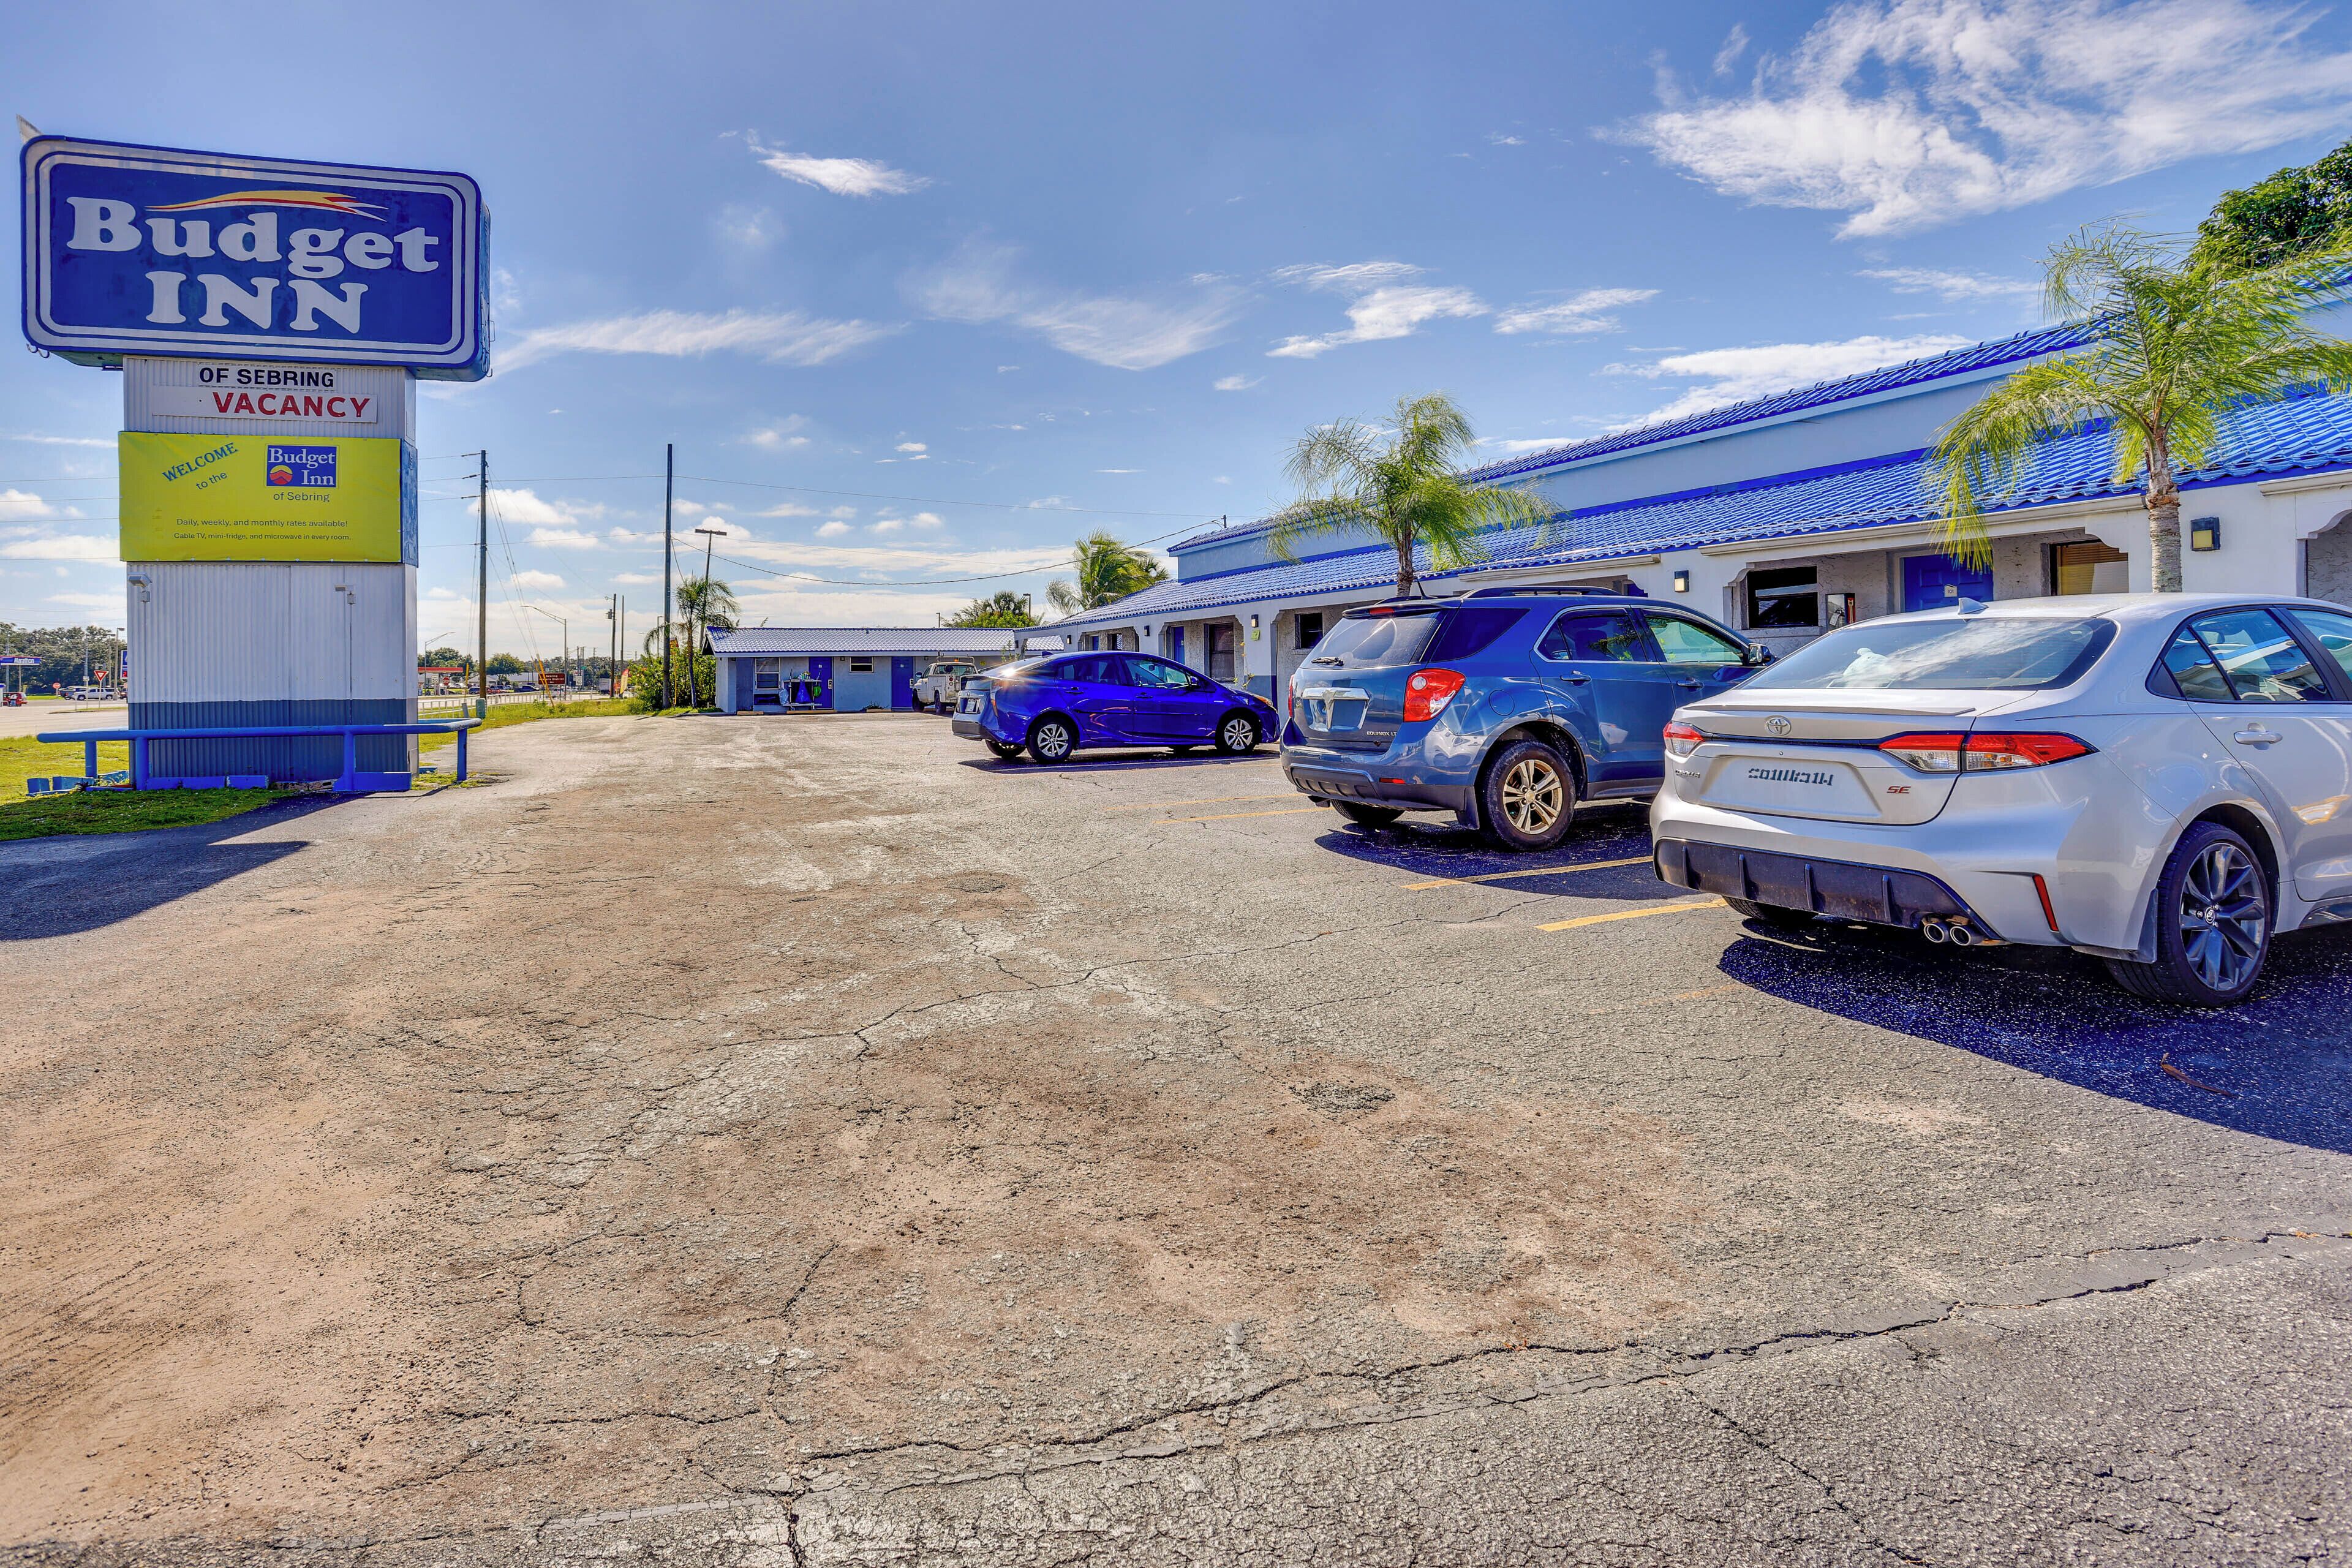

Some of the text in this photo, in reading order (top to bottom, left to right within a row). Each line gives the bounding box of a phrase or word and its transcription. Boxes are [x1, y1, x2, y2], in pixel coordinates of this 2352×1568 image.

[66, 196, 440, 279] Budget
[145, 270, 369, 334] INN
[198, 367, 334, 388] OF SEBRING
[212, 391, 371, 418] VACANCY
[162, 442, 239, 482] WELCOME
[268, 448, 336, 469] Budget
[195, 472, 228, 490] to the
[301, 469, 336, 486] Inn
[273, 491, 330, 502] of Sebring
[1887, 786, 1912, 794] SE
